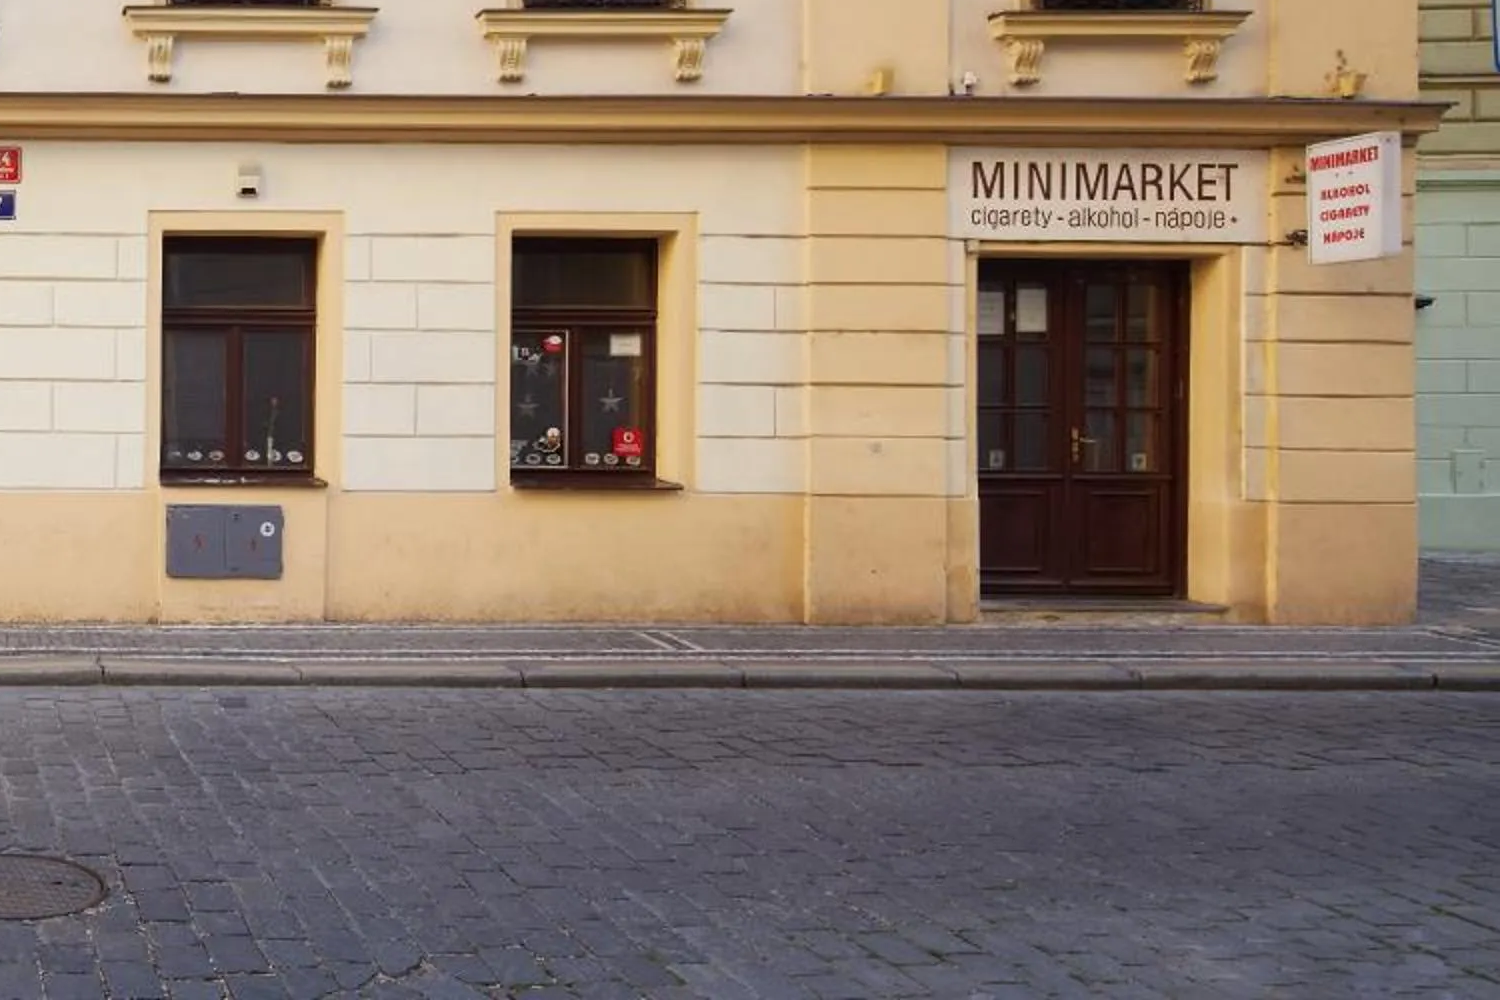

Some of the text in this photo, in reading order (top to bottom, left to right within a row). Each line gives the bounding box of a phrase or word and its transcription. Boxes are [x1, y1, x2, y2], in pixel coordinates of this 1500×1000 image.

[1308, 145, 1379, 171] MINIMARKET
[971, 161, 1239, 202] MINIMARKET
[1320, 184, 1371, 201] ALKOHOL
[971, 206, 1053, 230] cigarety
[1067, 207, 1139, 229] alkohol
[1155, 207, 1226, 231] nápoje
[1319, 204, 1370, 222] CIGARETY
